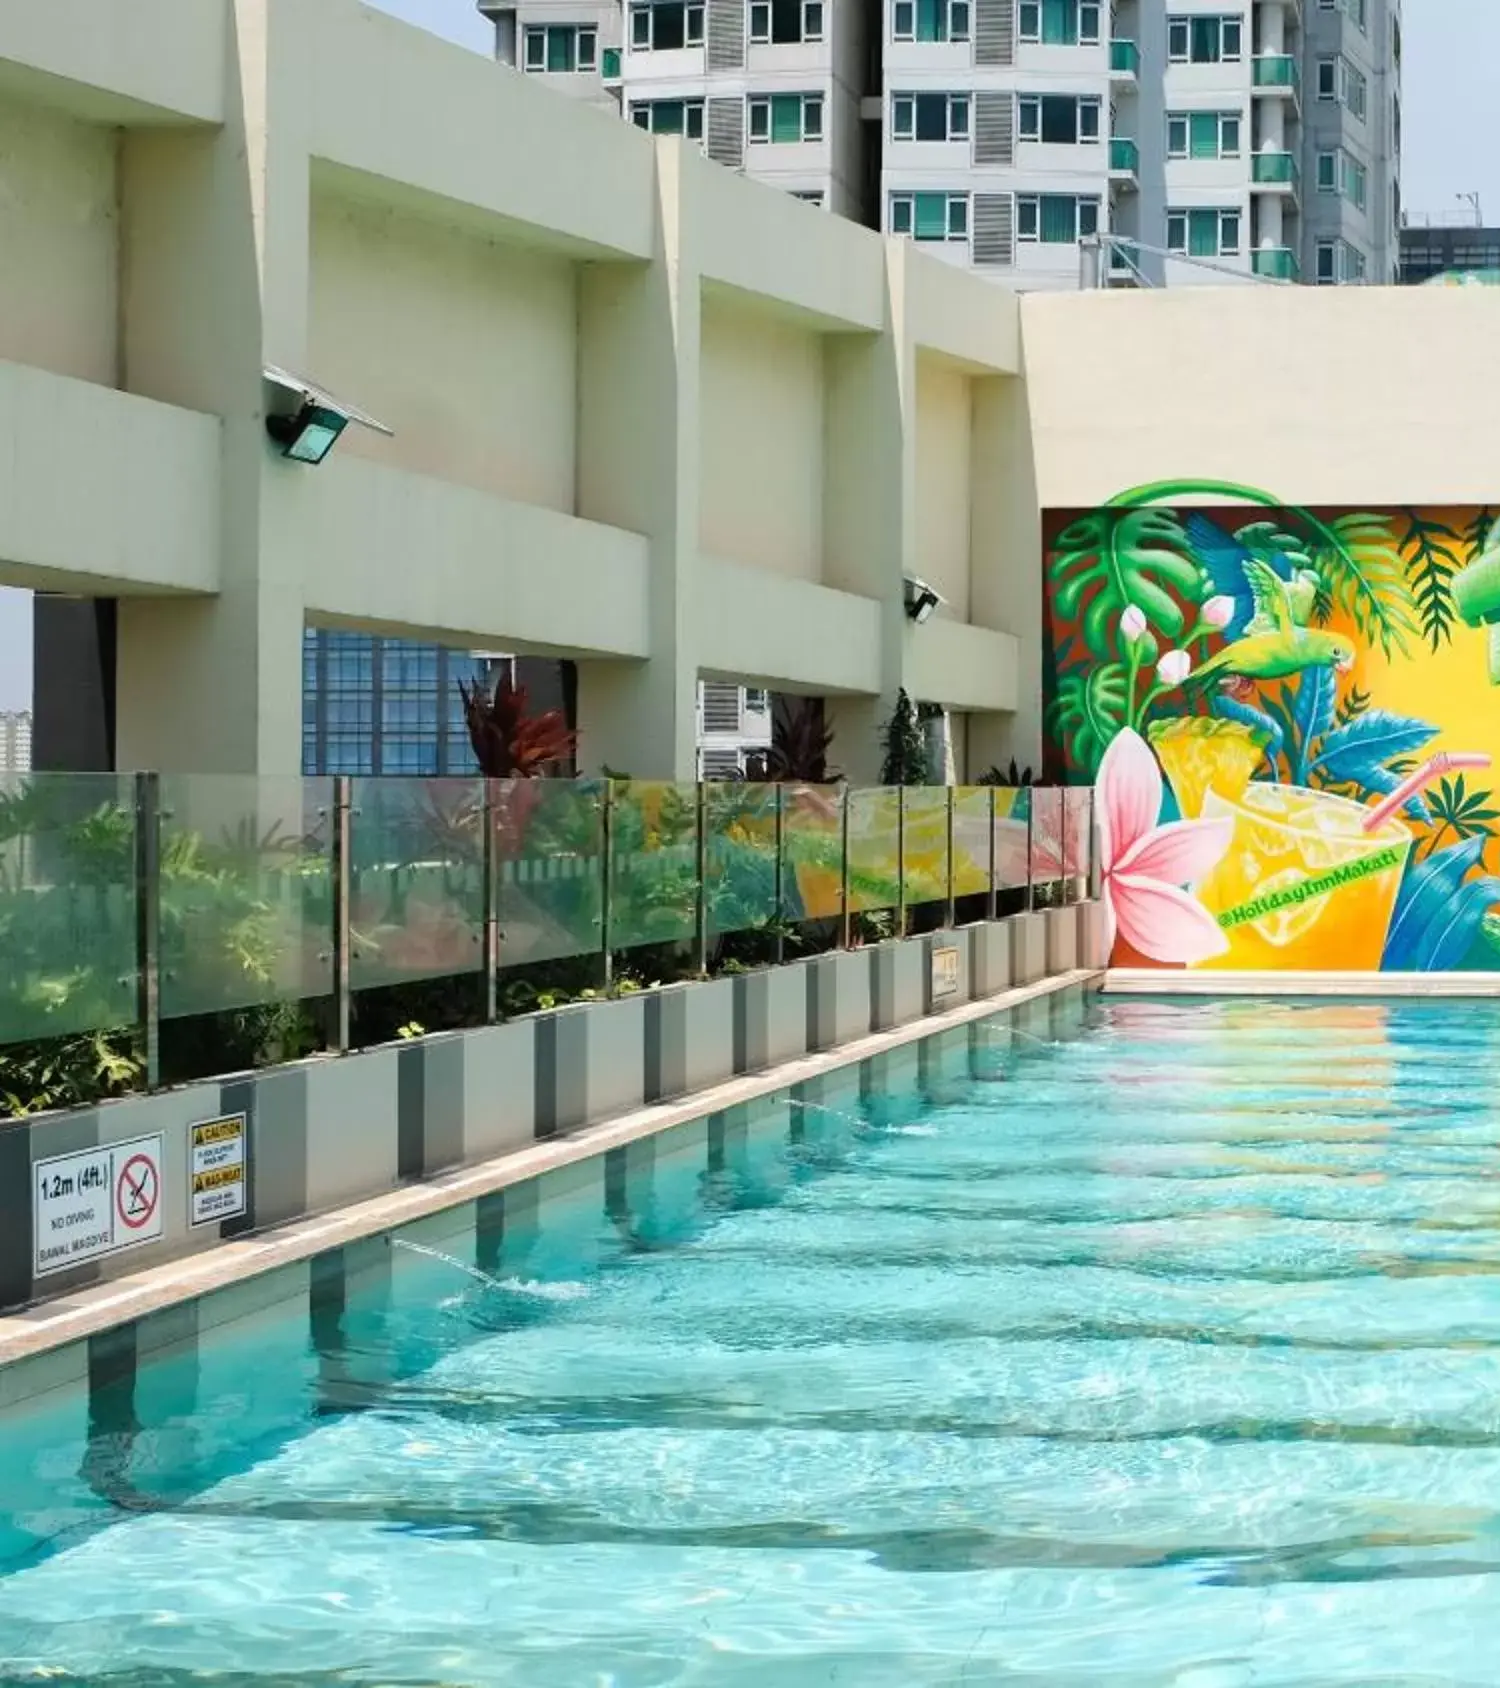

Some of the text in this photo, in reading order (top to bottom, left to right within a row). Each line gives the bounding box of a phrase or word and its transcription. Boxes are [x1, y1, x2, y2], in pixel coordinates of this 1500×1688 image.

[1218, 850, 1399, 928] @HolidayInnMakati
[41, 1163, 108, 1200] 1.2m (4ft.)
[51, 1207, 95, 1231] NO DIVING
